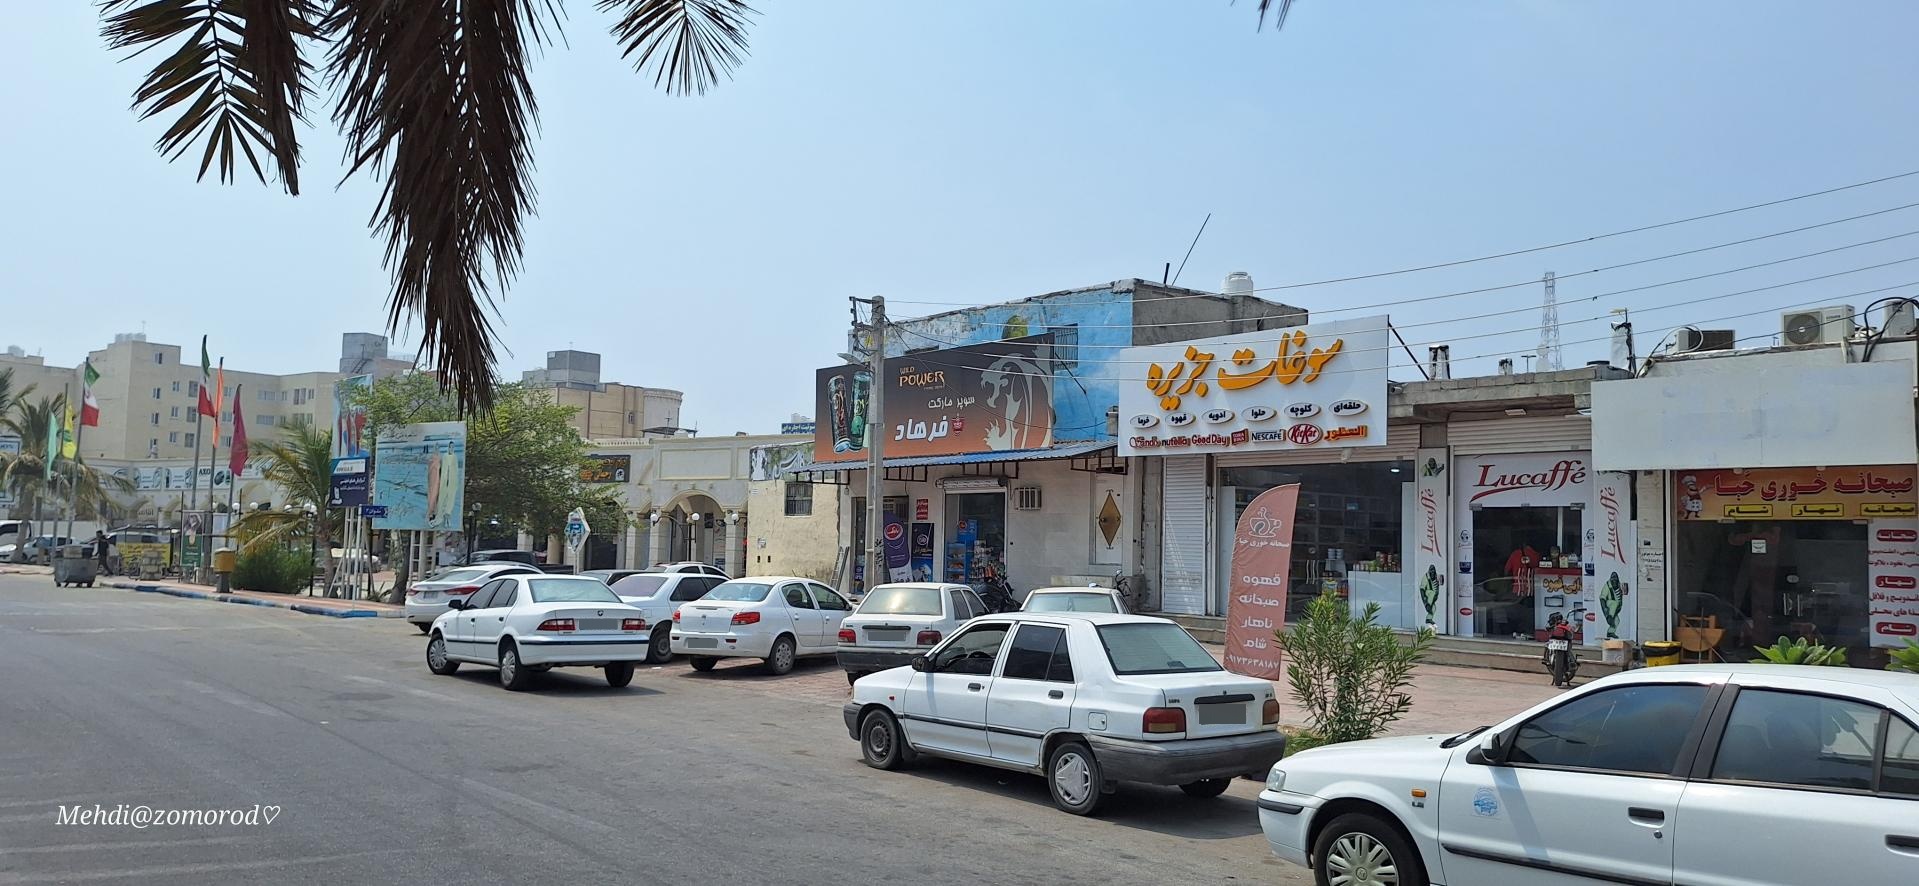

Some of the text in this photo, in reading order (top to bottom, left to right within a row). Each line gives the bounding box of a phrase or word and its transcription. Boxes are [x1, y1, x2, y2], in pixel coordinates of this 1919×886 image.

[1147, 330, 1344, 410] سوغات جزیره
[899, 371, 945, 387] POWER
[927, 396, 975, 410] سوپر مارکت
[1251, 409, 1266, 419] حلوا
[1290, 404, 1312, 416] کلوچه
[1137, 416, 1150, 426] خرما
[1171, 413, 1187, 424] قهوه
[894, 415, 949, 442] فرهاد
[1471, 460, 1586, 500] Lucaffé
[1833, 472, 1914, 498] صبحانه
[1761, 474, 1828, 501] خوری
[1797, 504, 1840, 516] نهار
[1420, 488, 1440, 556] Lucaffé
[1600, 486, 1624, 562] Lucaffé
[1242, 573, 1281, 586] قهوه
[1239, 594, 1279, 607] صبحانه
[1241, 617, 1273, 629] ناهار
[1243, 637, 1267, 649] شام
